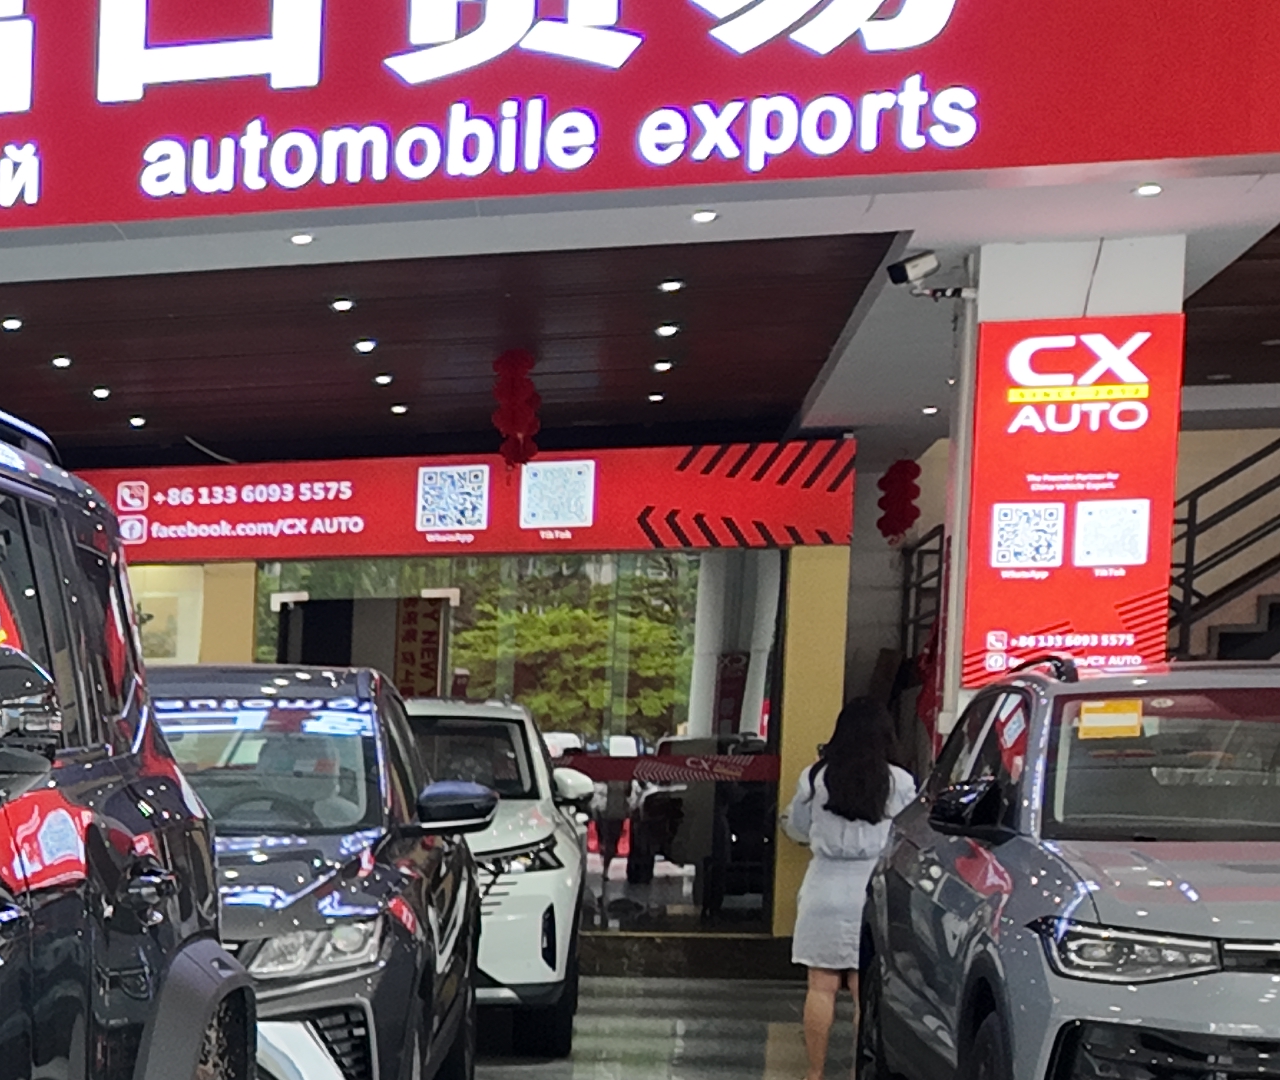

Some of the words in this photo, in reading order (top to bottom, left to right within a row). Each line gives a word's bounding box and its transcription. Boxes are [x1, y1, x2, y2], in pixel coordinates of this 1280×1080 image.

[140, 95, 599, 197] automobile
[638, 74, 978, 170] exports
[1008, 332, 1152, 386] CX
[1007, 401, 1148, 432] AUTO
[153, 487, 194, 507] +86
[198, 486, 236, 505] 133
[241, 483, 294, 504] 6093
[299, 481, 352, 501] 5575
[151, 517, 307, 539] facebook.com/CX
[311, 517, 364, 534] AUTO
